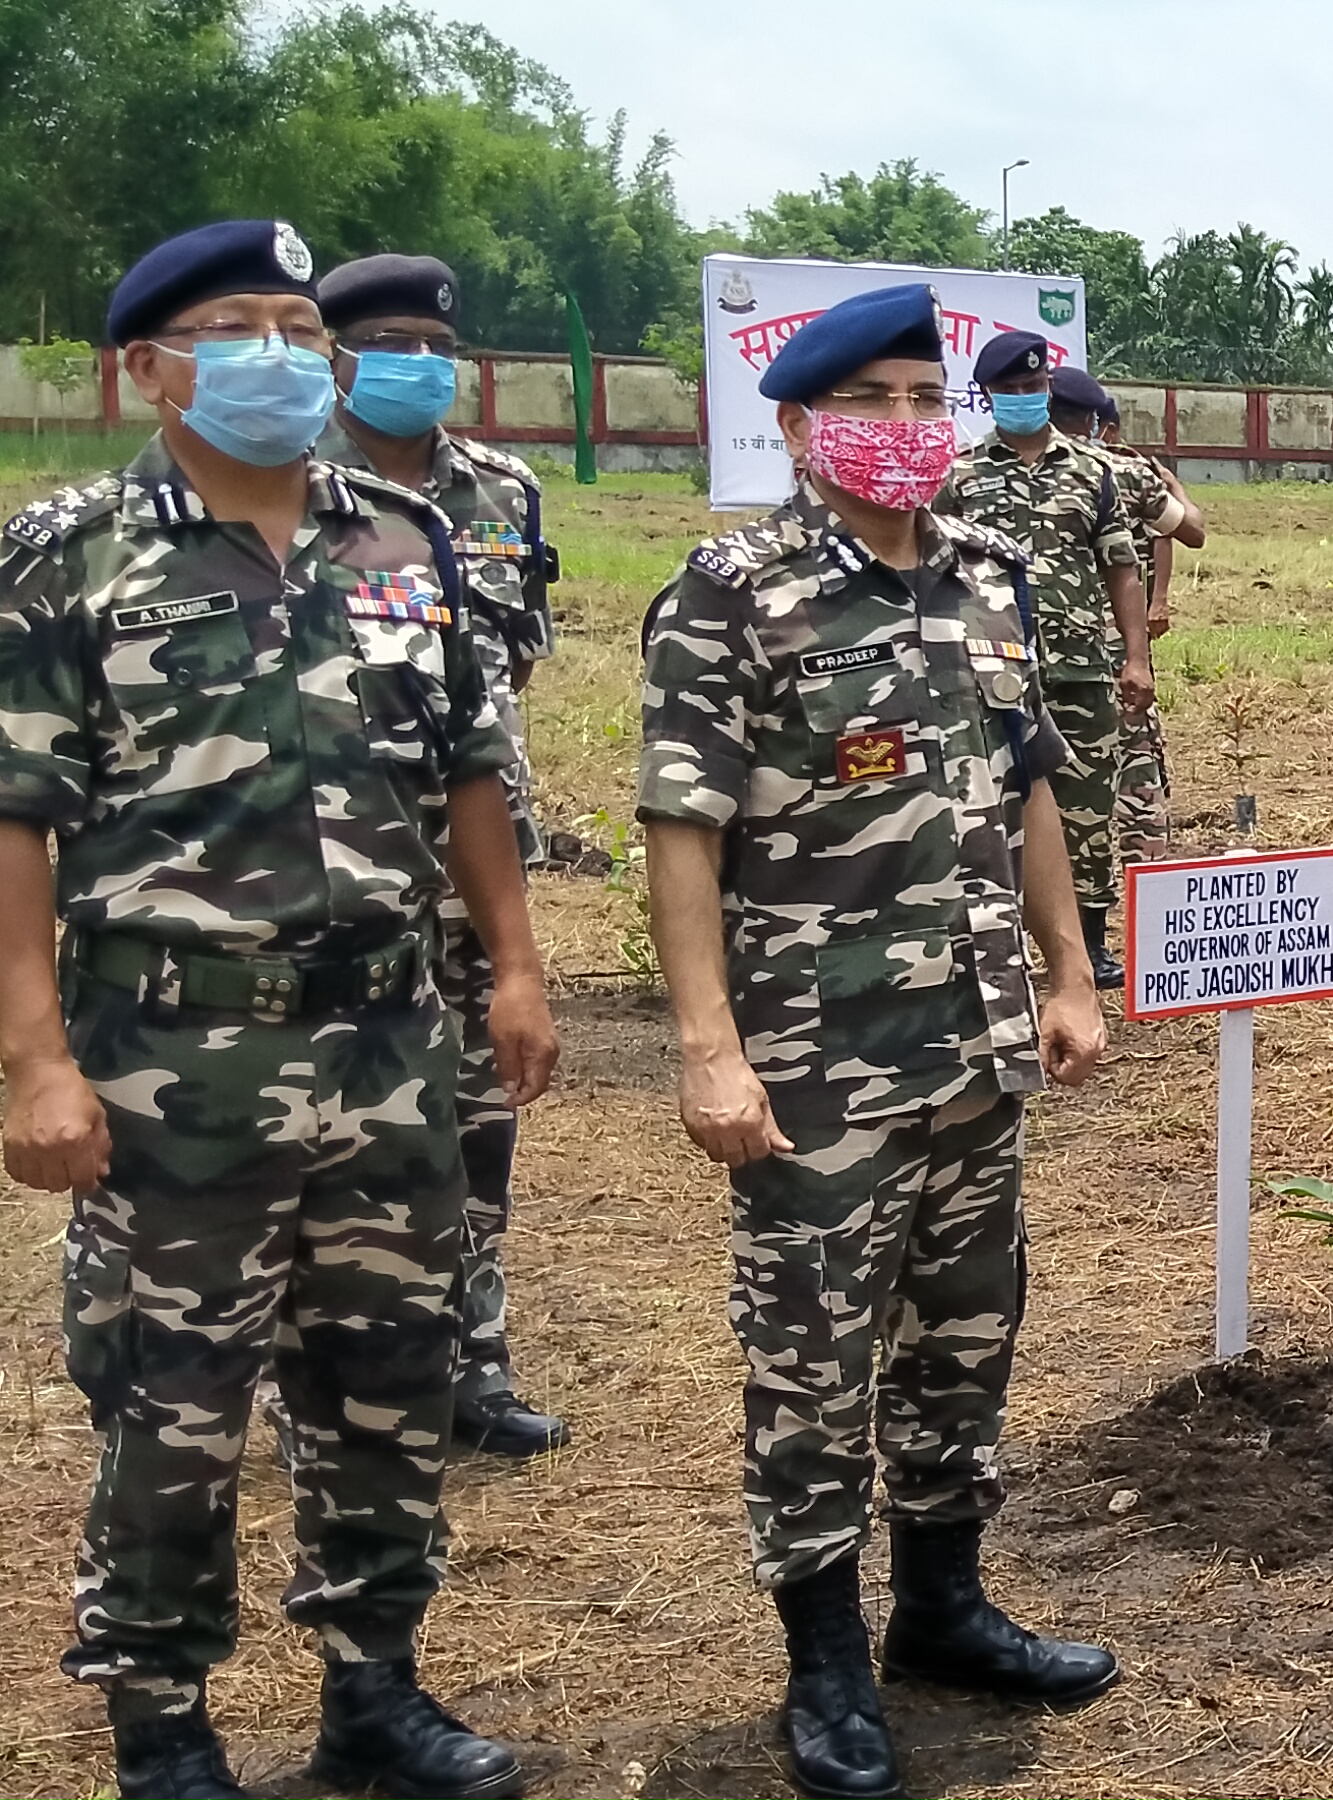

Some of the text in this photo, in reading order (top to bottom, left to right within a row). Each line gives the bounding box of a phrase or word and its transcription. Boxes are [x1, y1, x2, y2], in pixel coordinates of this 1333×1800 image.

[732, 438, 747, 450] 15
[9, 516, 52, 545] SSB
[697, 550, 736, 576] SSB
[816, 648, 878, 669] PRADEEP
[1187, 868, 1299, 902] PLANTED BY
[1165, 896, 1320, 935] HIS EXCELLENCY
[1164, 925, 1331, 964] GOVERNOR OF ASSAM
[1145, 970, 1191, 1004] PROF.
[1196, 960, 1274, 998] JAGDISH
